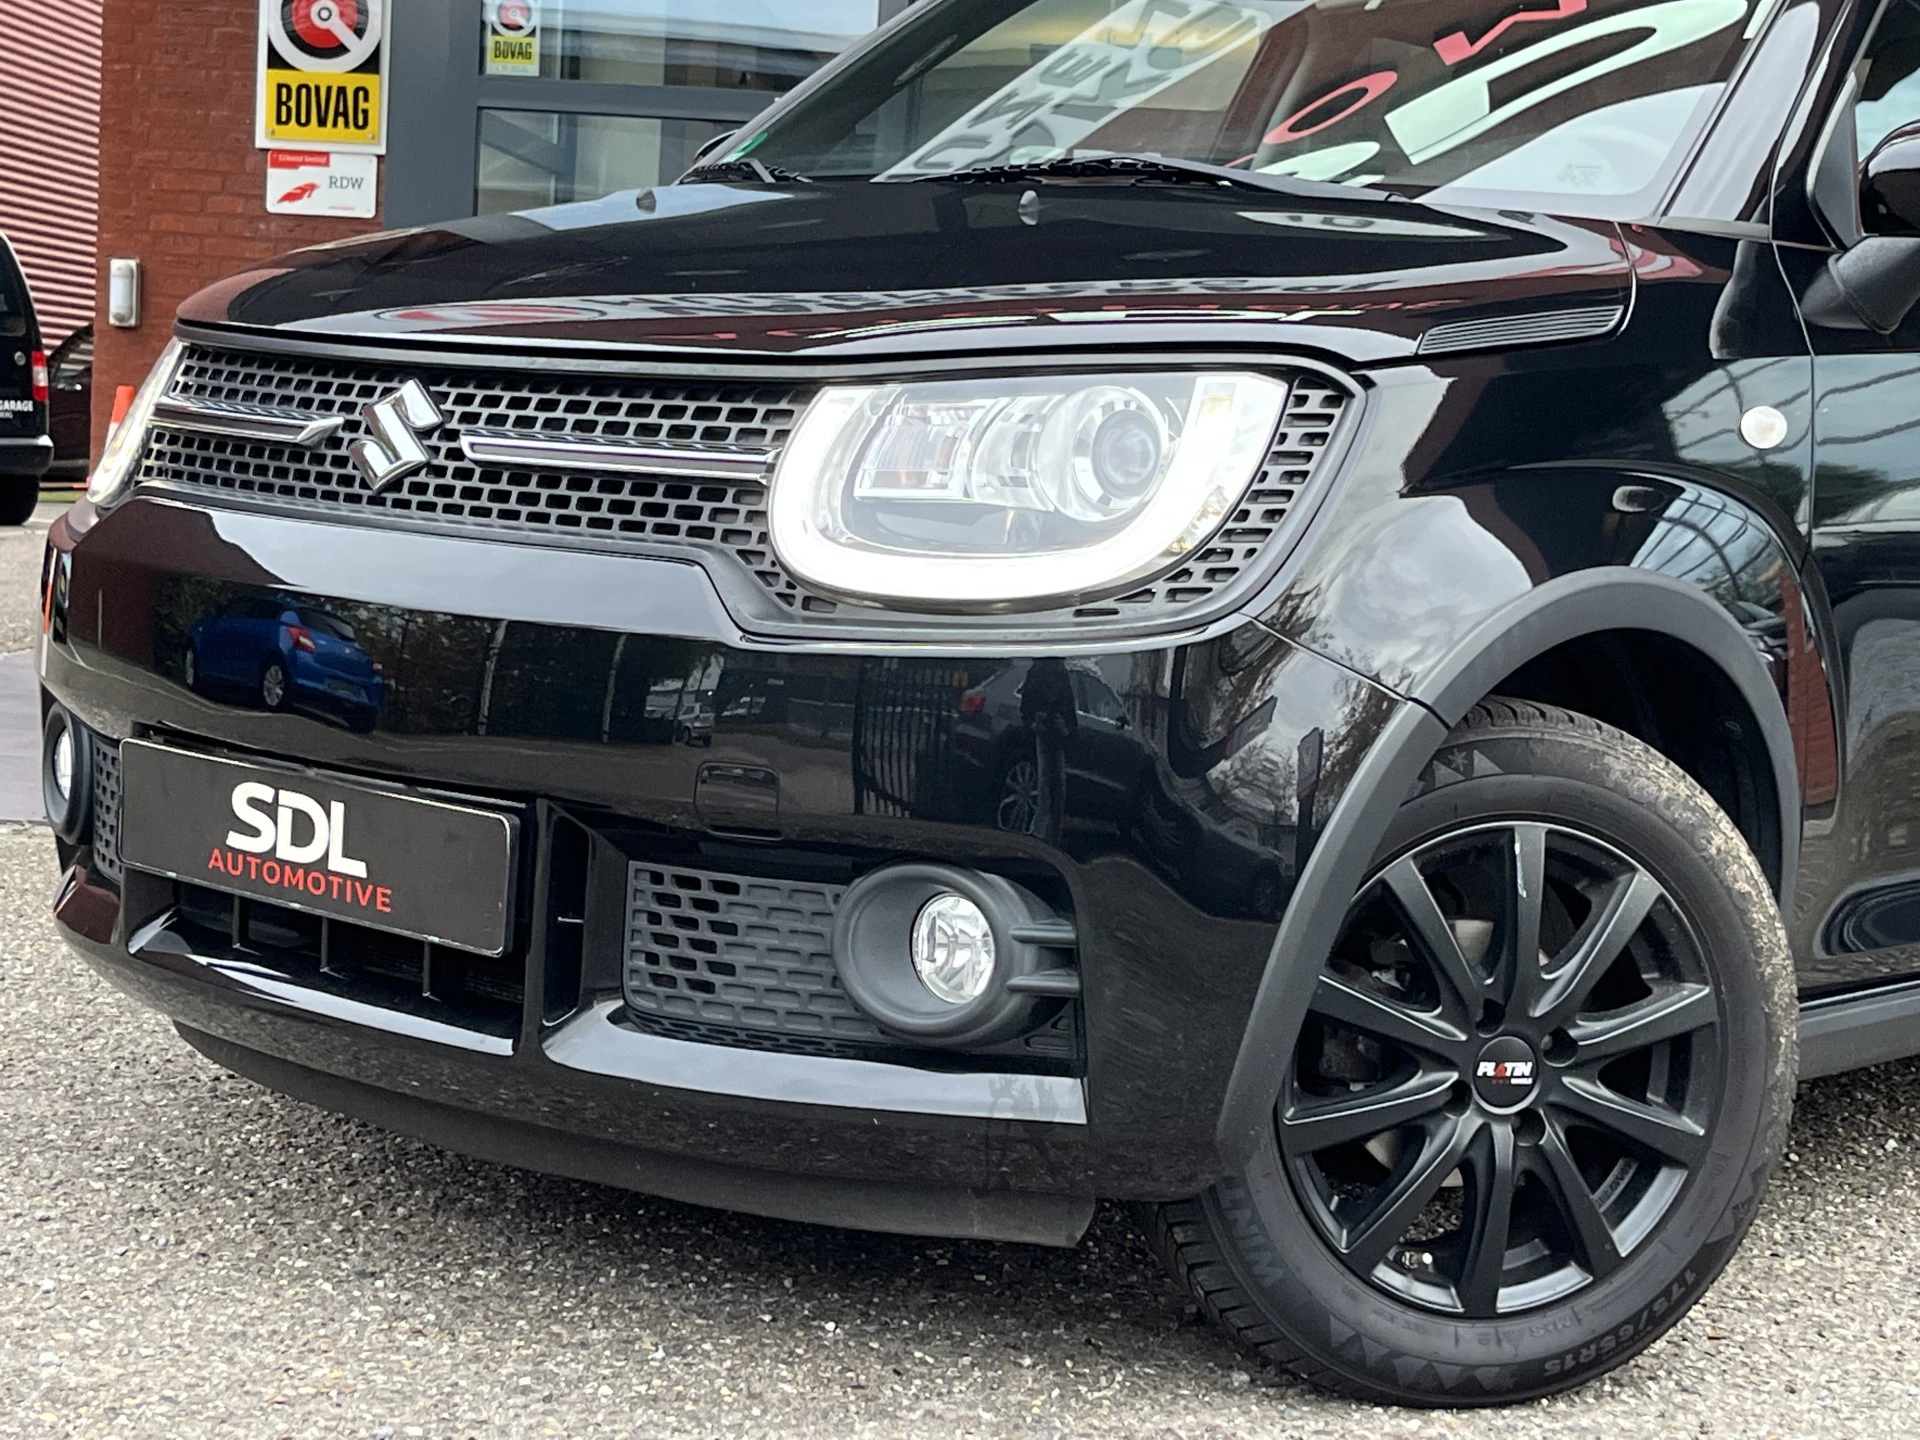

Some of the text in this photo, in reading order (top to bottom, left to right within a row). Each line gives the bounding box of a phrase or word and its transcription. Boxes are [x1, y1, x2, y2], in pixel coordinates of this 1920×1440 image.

[494, 40, 533, 61] BOVAG
[276, 82, 370, 131] BOVAG
[328, 175, 365, 190] RDW
[225, 781, 368, 879] SDL
[207, 847, 393, 913] AUTOMOTIVE
[1543, 1268, 1697, 1377] 175/65R15
